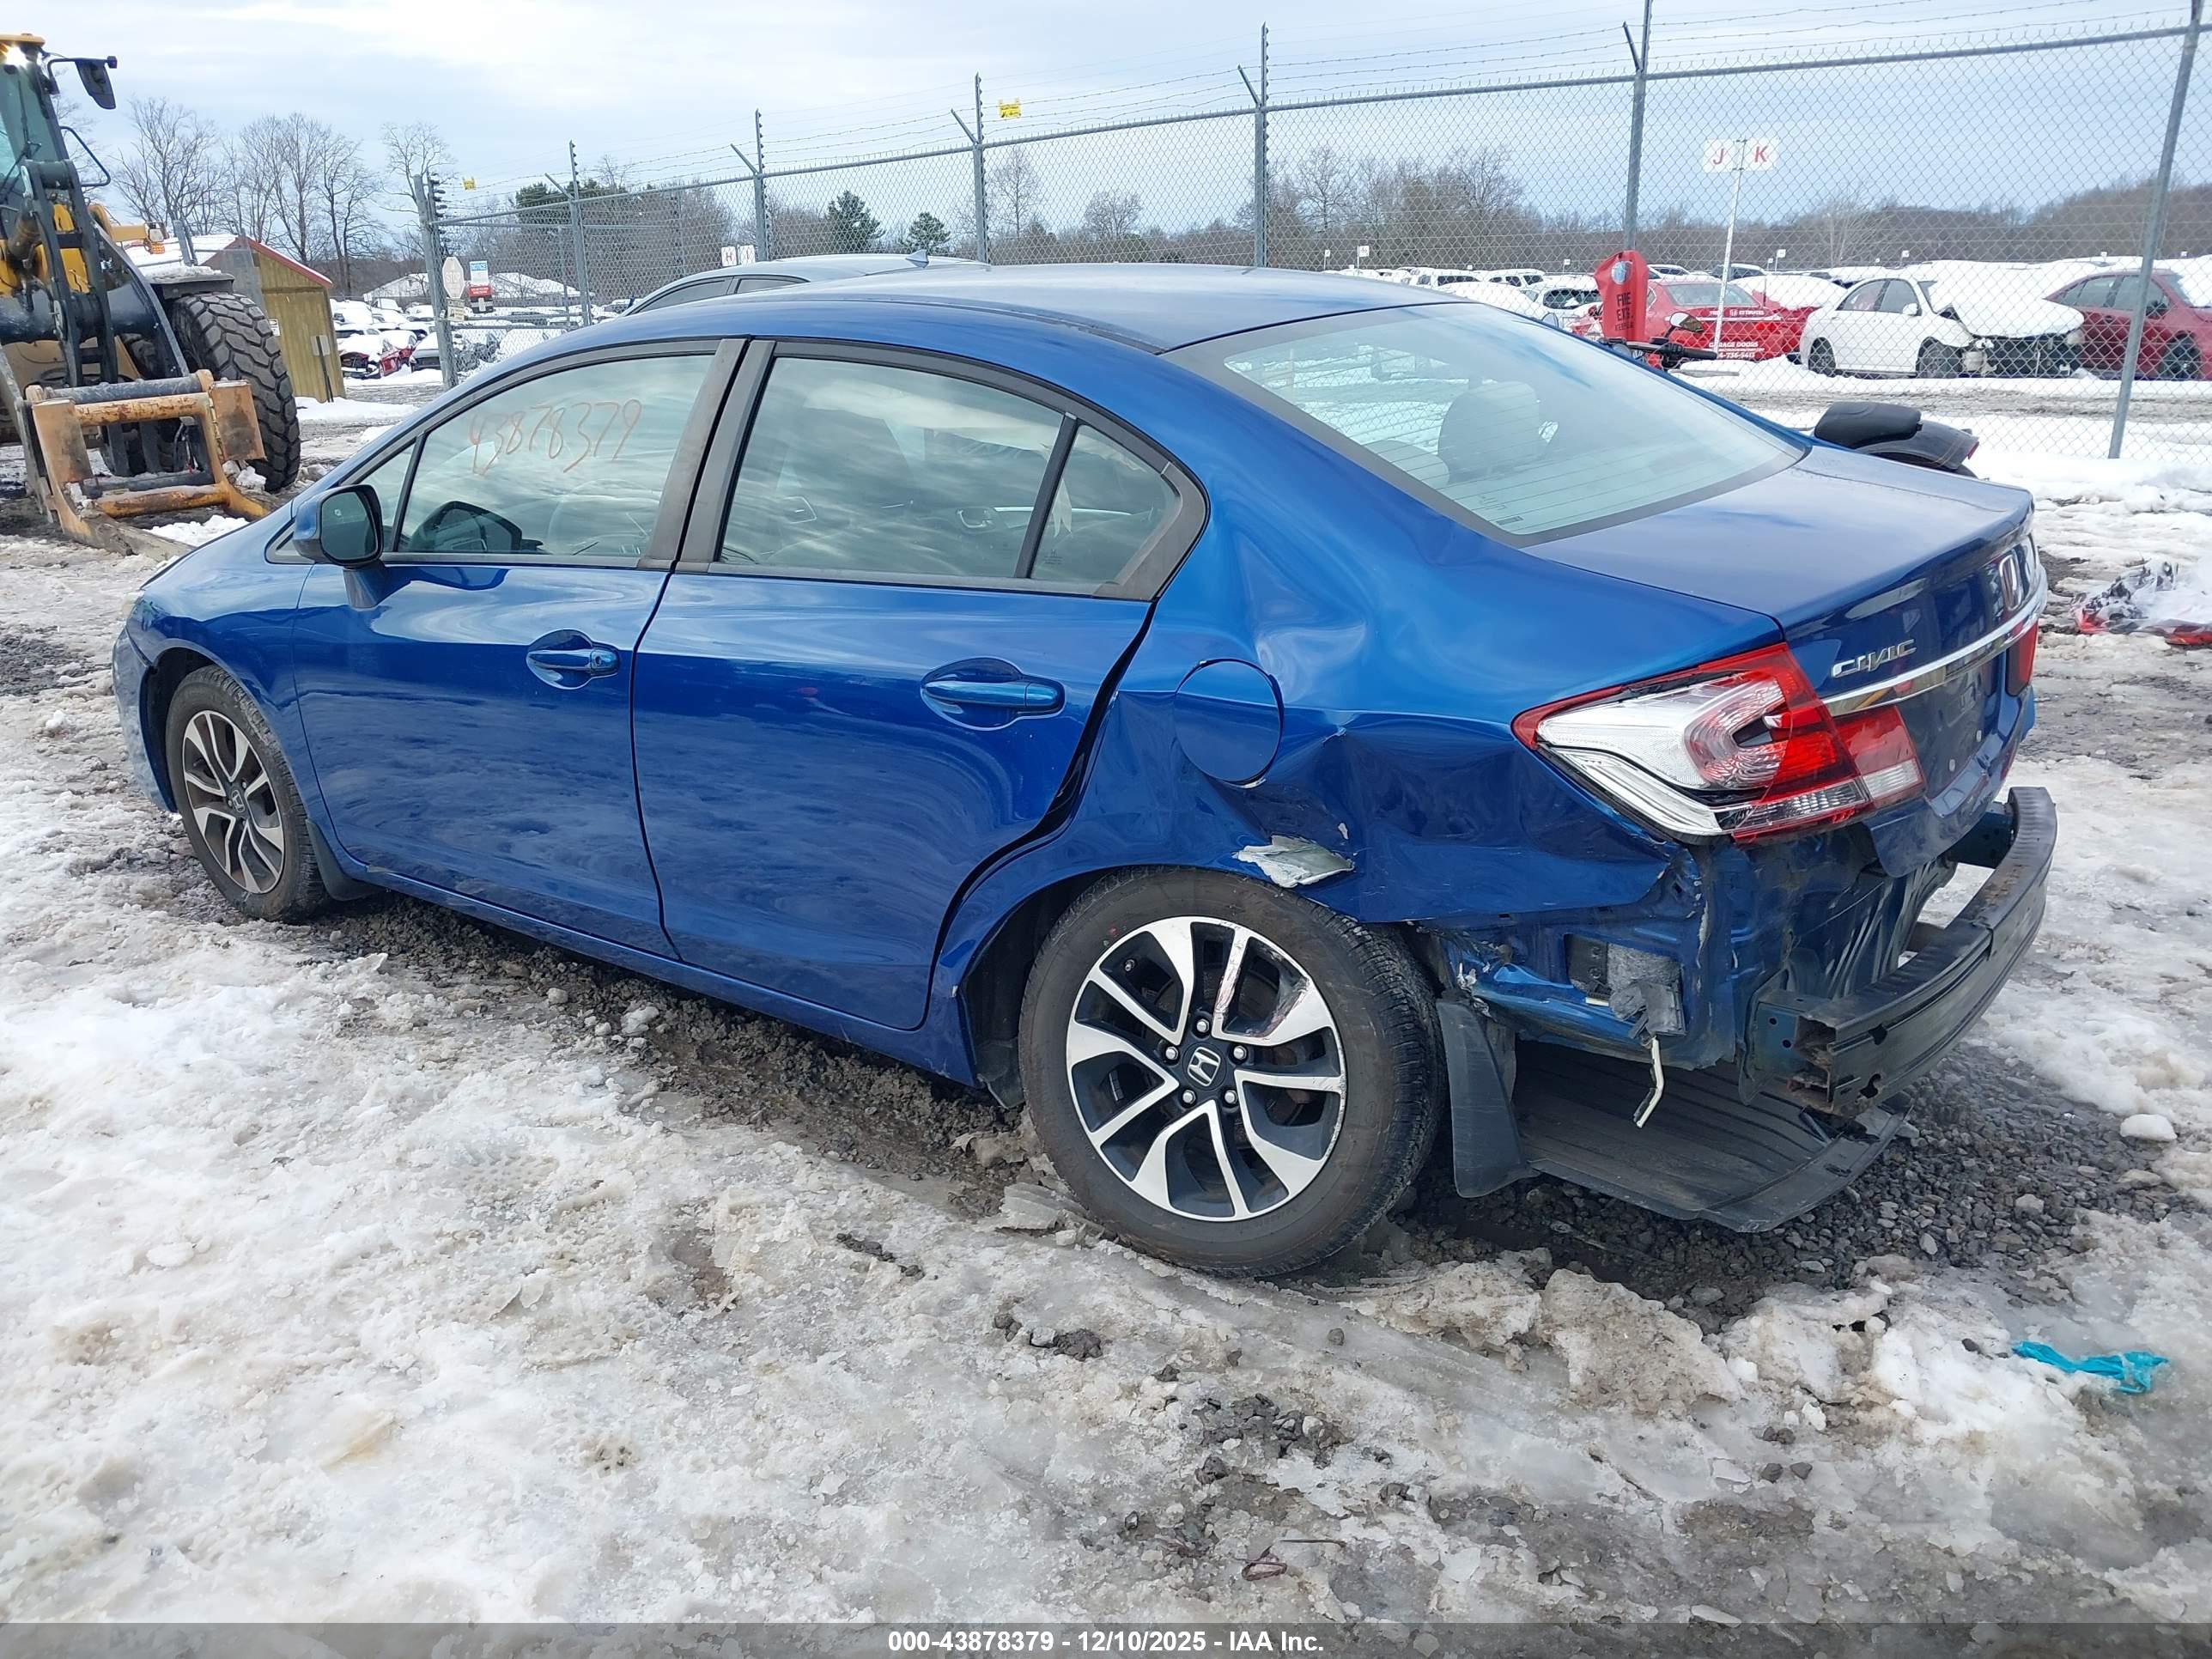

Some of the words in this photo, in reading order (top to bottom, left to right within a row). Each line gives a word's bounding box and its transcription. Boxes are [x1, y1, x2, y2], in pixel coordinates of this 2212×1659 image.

[1713, 148, 1724, 165] J
[1754, 146, 1769, 163] K
[446, 270, 461, 283] STOP
[469, 398, 643, 477] 43878379
[1832, 638, 1917, 678] CIVIC
